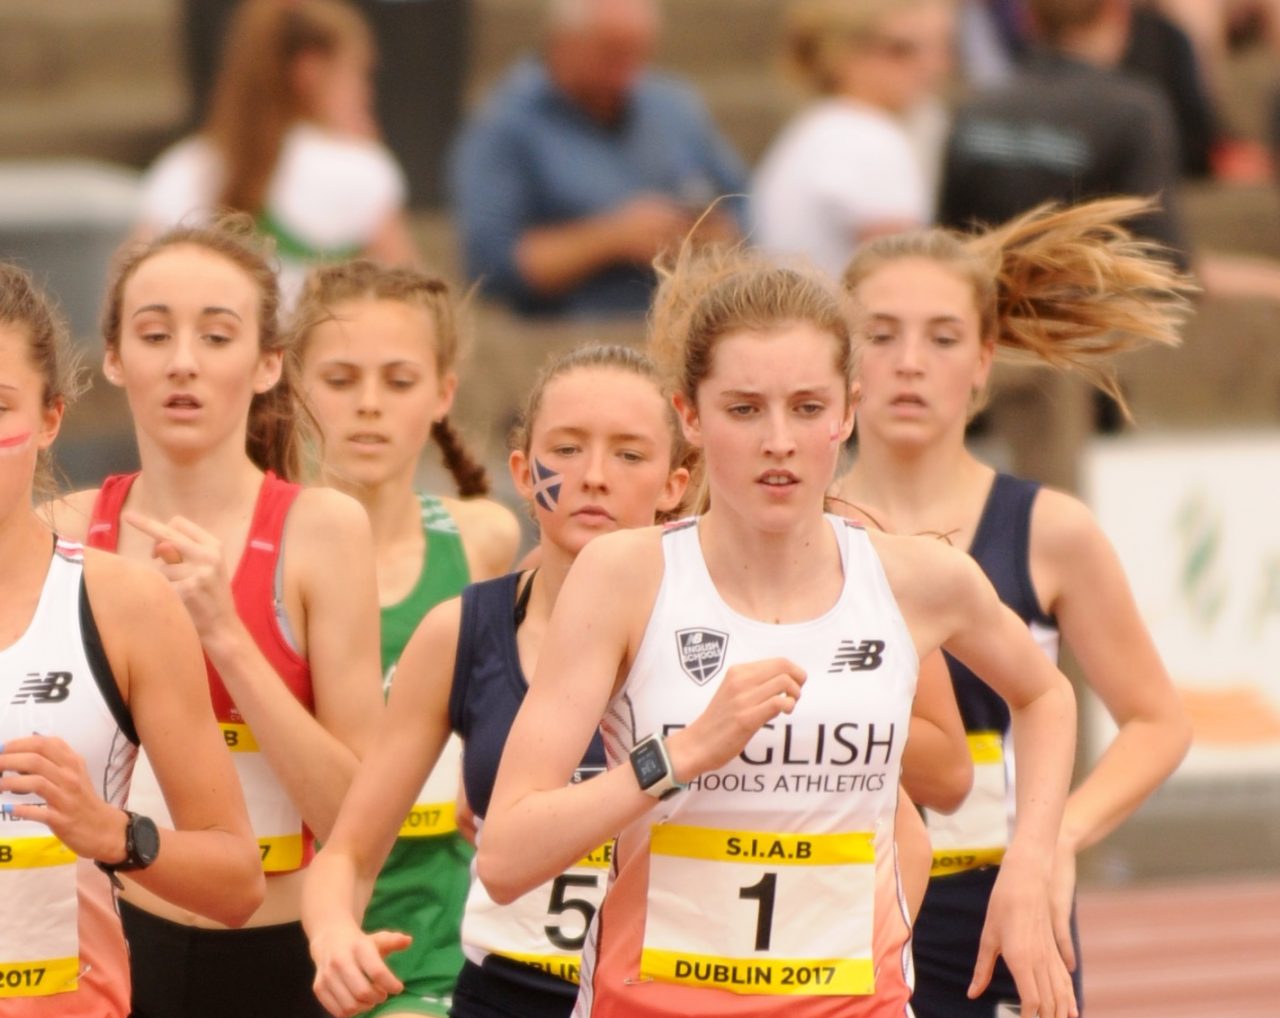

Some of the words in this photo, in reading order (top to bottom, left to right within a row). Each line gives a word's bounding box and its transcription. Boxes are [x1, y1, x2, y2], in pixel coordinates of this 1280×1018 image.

[662, 722, 895, 766] GLISH
[687, 773, 765, 793] HOOLS
[773, 772, 886, 793] ATHLETICS
[403, 809, 441, 828] 017
[726, 837, 812, 859] S.I.A.B
[544, 873, 598, 951] 5
[739, 872, 777, 951] 1
[674, 960, 772, 985] DUBLIN
[780, 966, 836, 985] 2017
